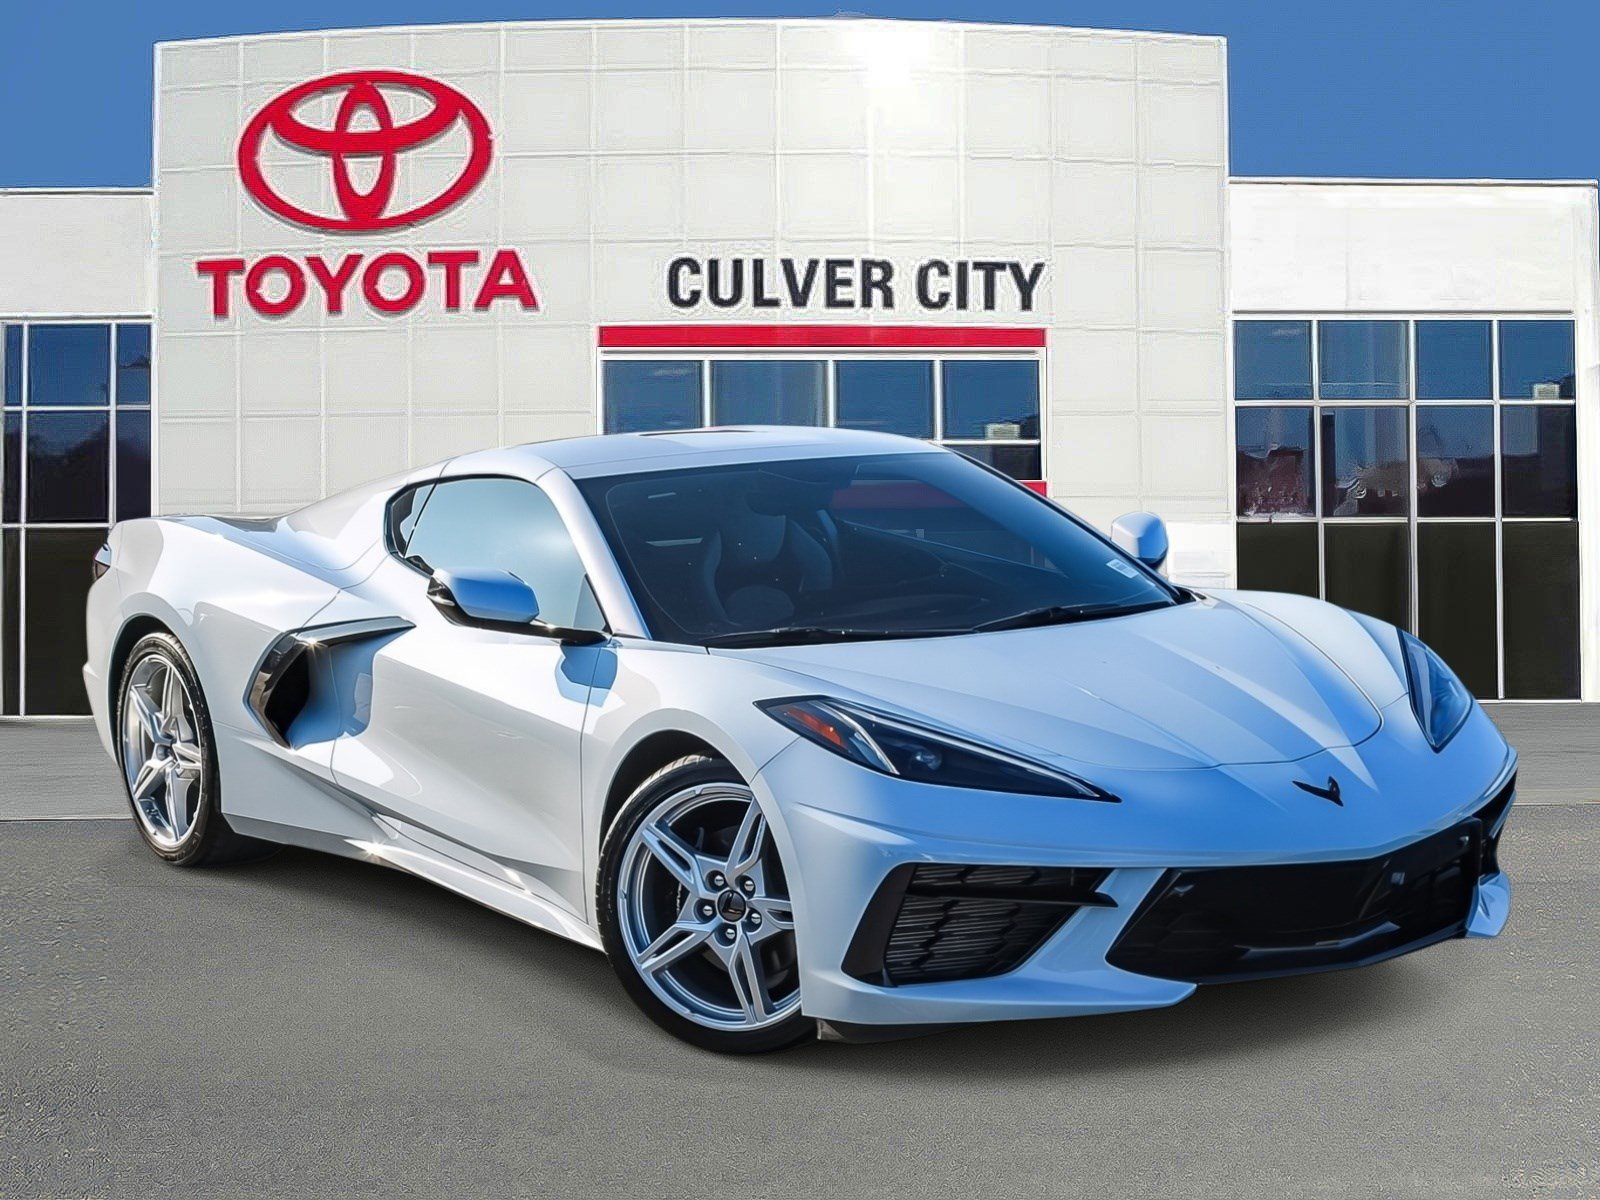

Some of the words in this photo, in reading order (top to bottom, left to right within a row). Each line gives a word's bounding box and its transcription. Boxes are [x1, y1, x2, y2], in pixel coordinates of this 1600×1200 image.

[196, 250, 539, 317] TOYOTA
[667, 257, 895, 309] CULVER
[915, 259, 1046, 312] CITY
